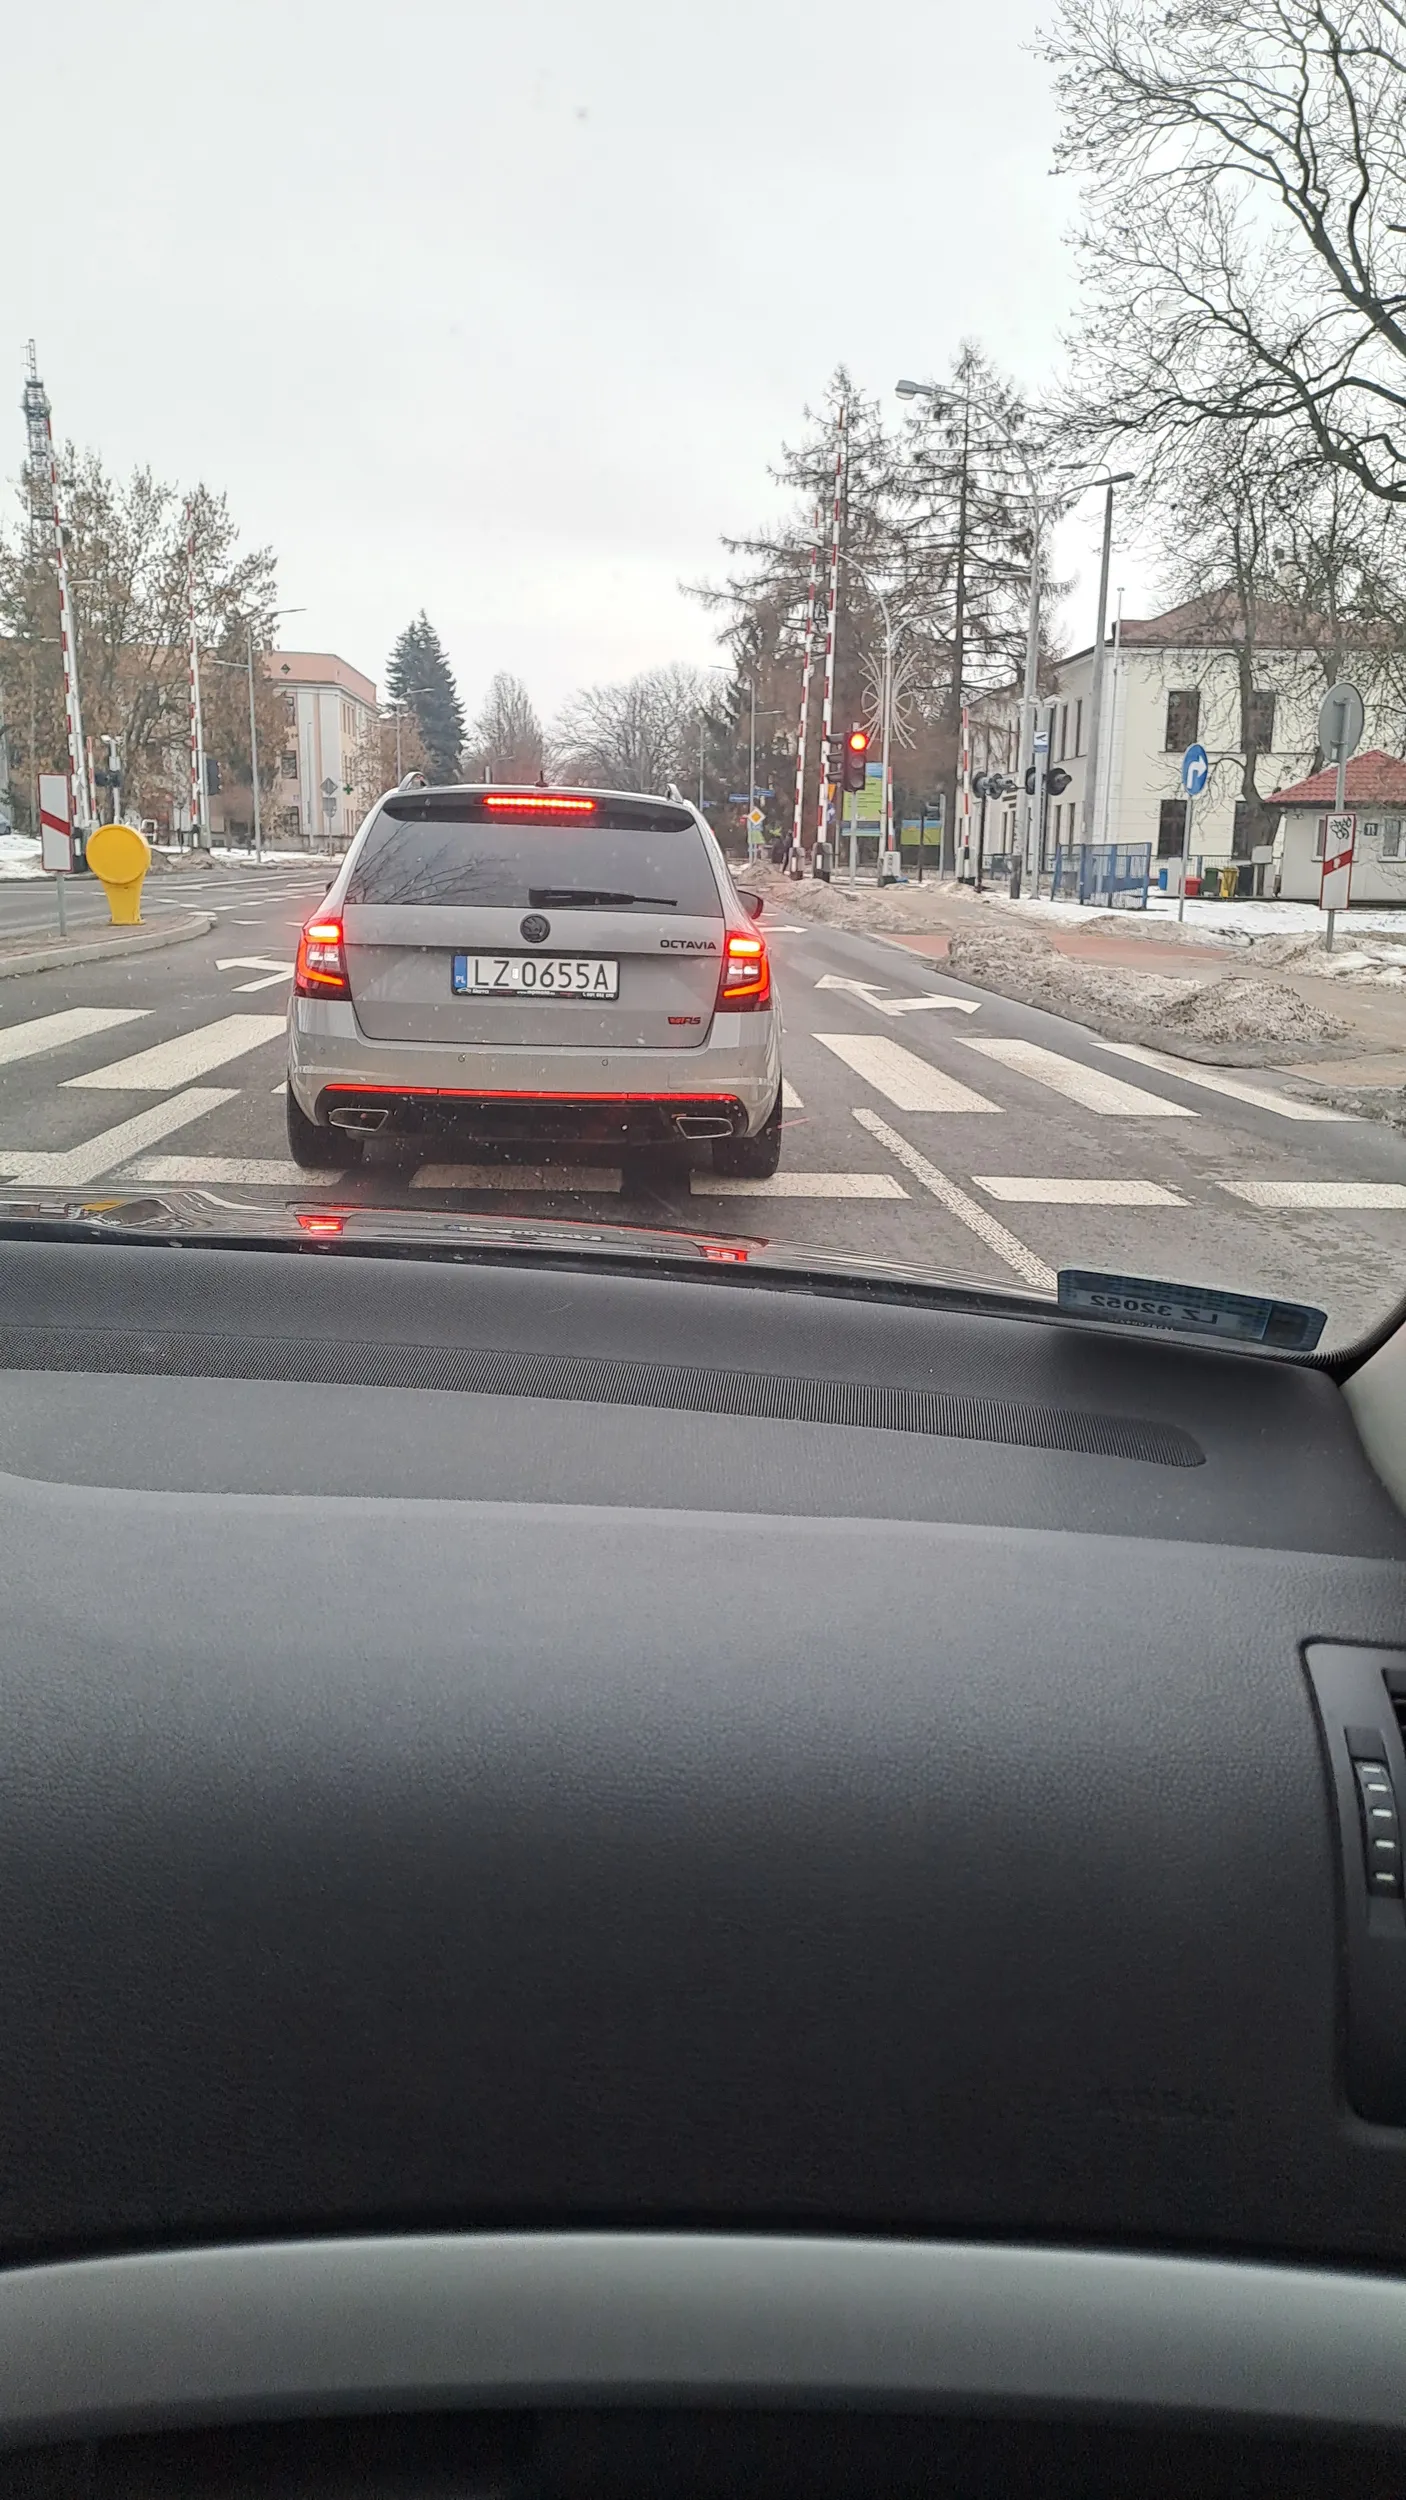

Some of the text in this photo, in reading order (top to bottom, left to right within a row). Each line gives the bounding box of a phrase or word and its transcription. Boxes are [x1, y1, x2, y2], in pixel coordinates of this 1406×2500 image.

[660, 939, 717, 950] OCTAVIA
[455, 975, 466, 984] PL
[474, 959, 609, 991] LZ 0655A
